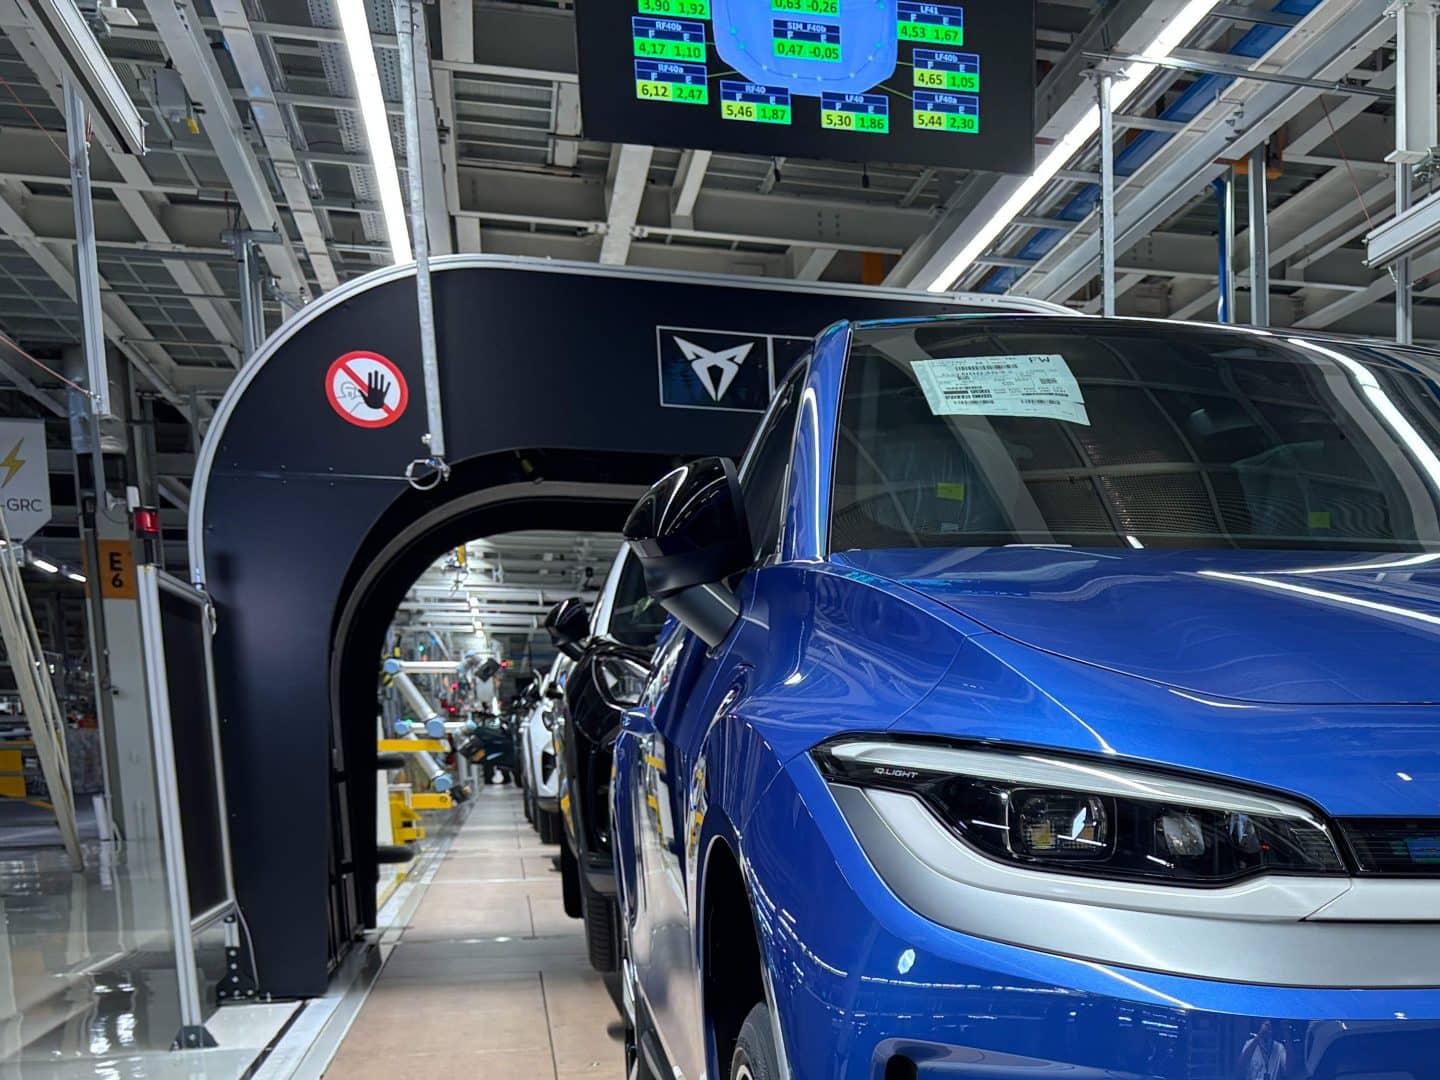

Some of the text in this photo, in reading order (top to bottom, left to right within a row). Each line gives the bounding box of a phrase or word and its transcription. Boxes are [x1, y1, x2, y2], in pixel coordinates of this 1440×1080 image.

[643, 0, 705, 15] 3,90 1,92
[807, 0, 837, 13] -0,26
[920, 5, 938, 15] LF41
[910, 14, 949, 25] F E
[648, 30, 690, 42] F E
[787, 31, 827, 43] F E
[901, 25, 959, 41] 4,53 1,67
[638, 42, 701, 58] 4,17 1,10
[777, 42, 839, 59] 0,47 -0,05
[928, 61, 965, 72] F E
[651, 72, 692, 84] F E
[918, 73, 975, 88] 4,65 1,05
[641, 84, 703, 100] 6,12 2,47
[736, 93, 776, 105] F E
[726, 104, 786, 120] 5,46 1,87
[835, 102, 875, 114] F E
[927, 103, 965, 114] F E
[826, 114, 885, 129] 5,30 1,86
[918, 114, 974, 130] 5,44 2,30
[109, 552, 123, 572] E
[112, 574, 123, 588] 6
